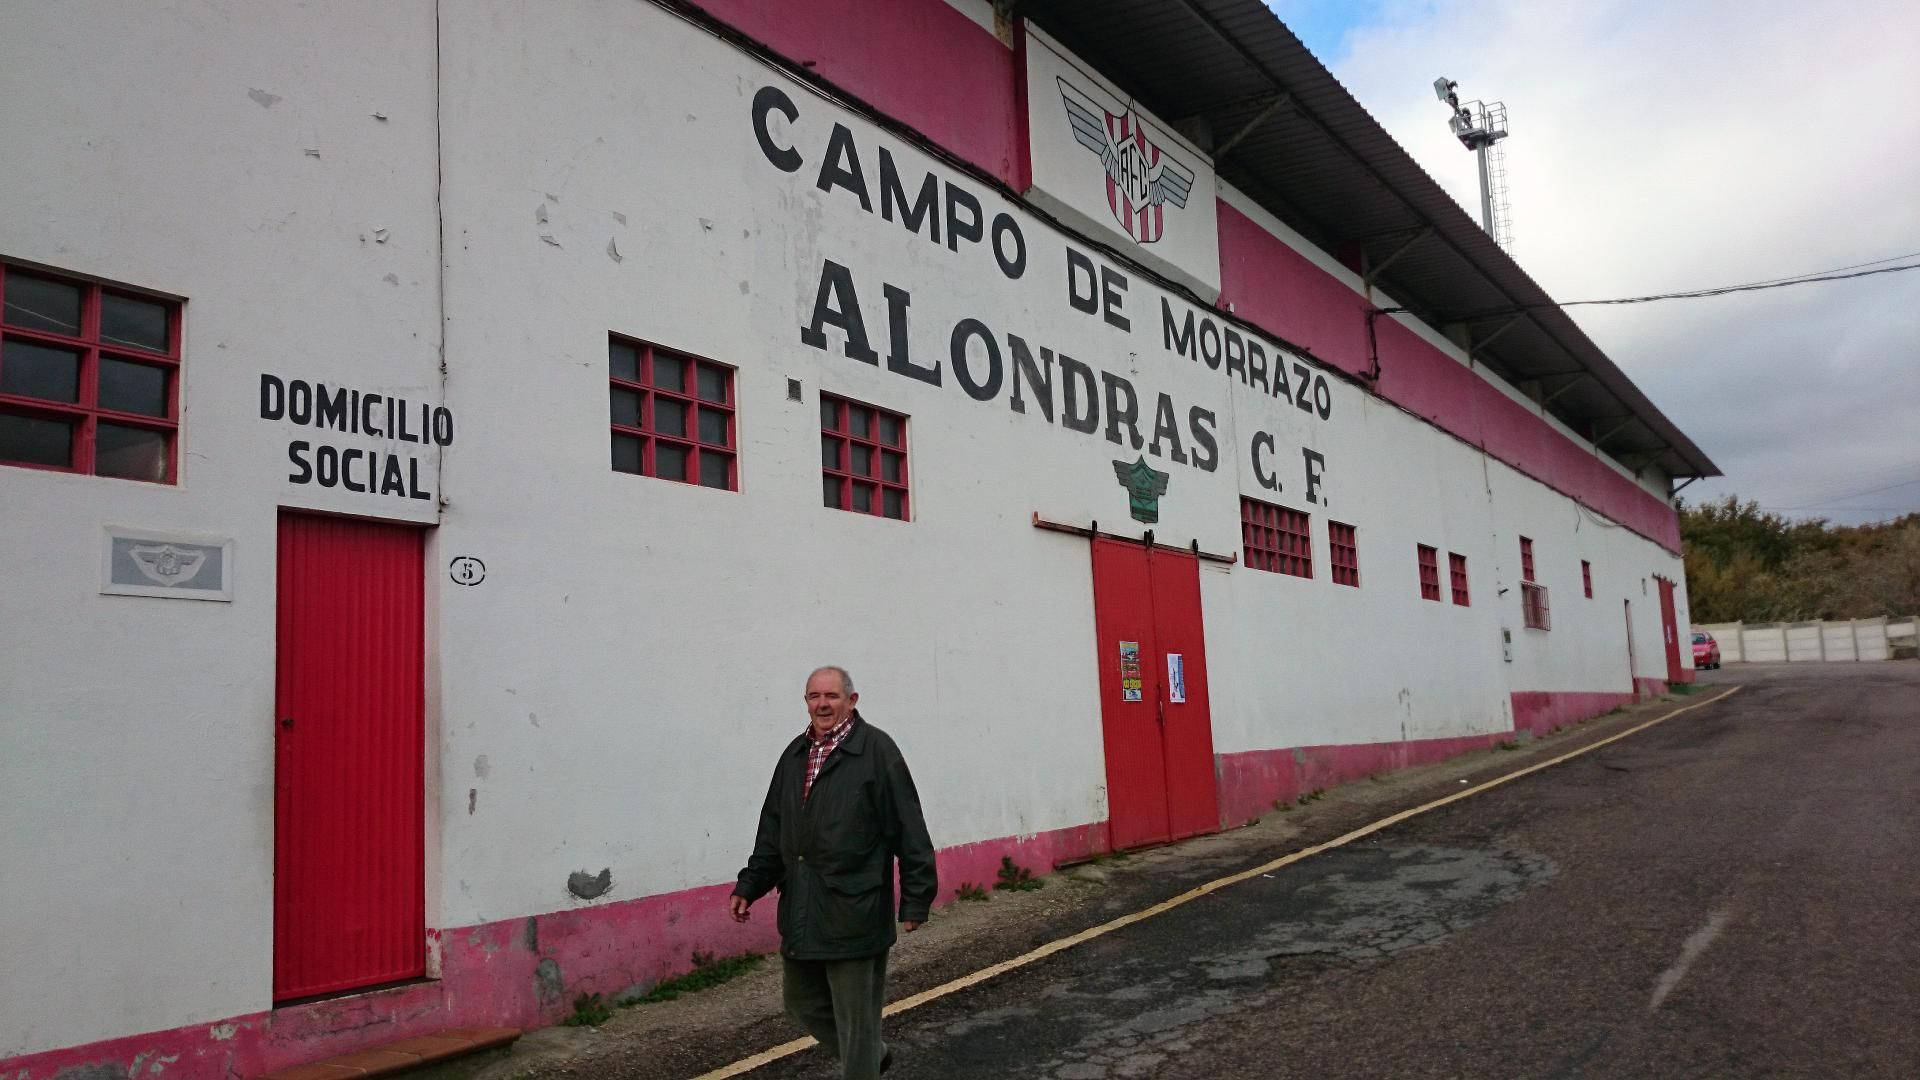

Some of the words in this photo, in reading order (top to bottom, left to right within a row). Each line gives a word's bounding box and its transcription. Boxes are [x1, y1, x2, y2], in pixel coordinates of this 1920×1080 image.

[752, 86, 1027, 280] CAMPO
[1066, 246, 1131, 333] DE
[1161, 297, 1331, 421] MORRAZO
[260, 373, 454, 447] DOMICILIO
[801, 259, 1219, 472] ALONDRAS
[1251, 431, 1283, 492] C.
[1302, 447, 1328, 507] F.
[288, 440, 431, 500] SOCIAL
[462, 562, 473, 581] 5
